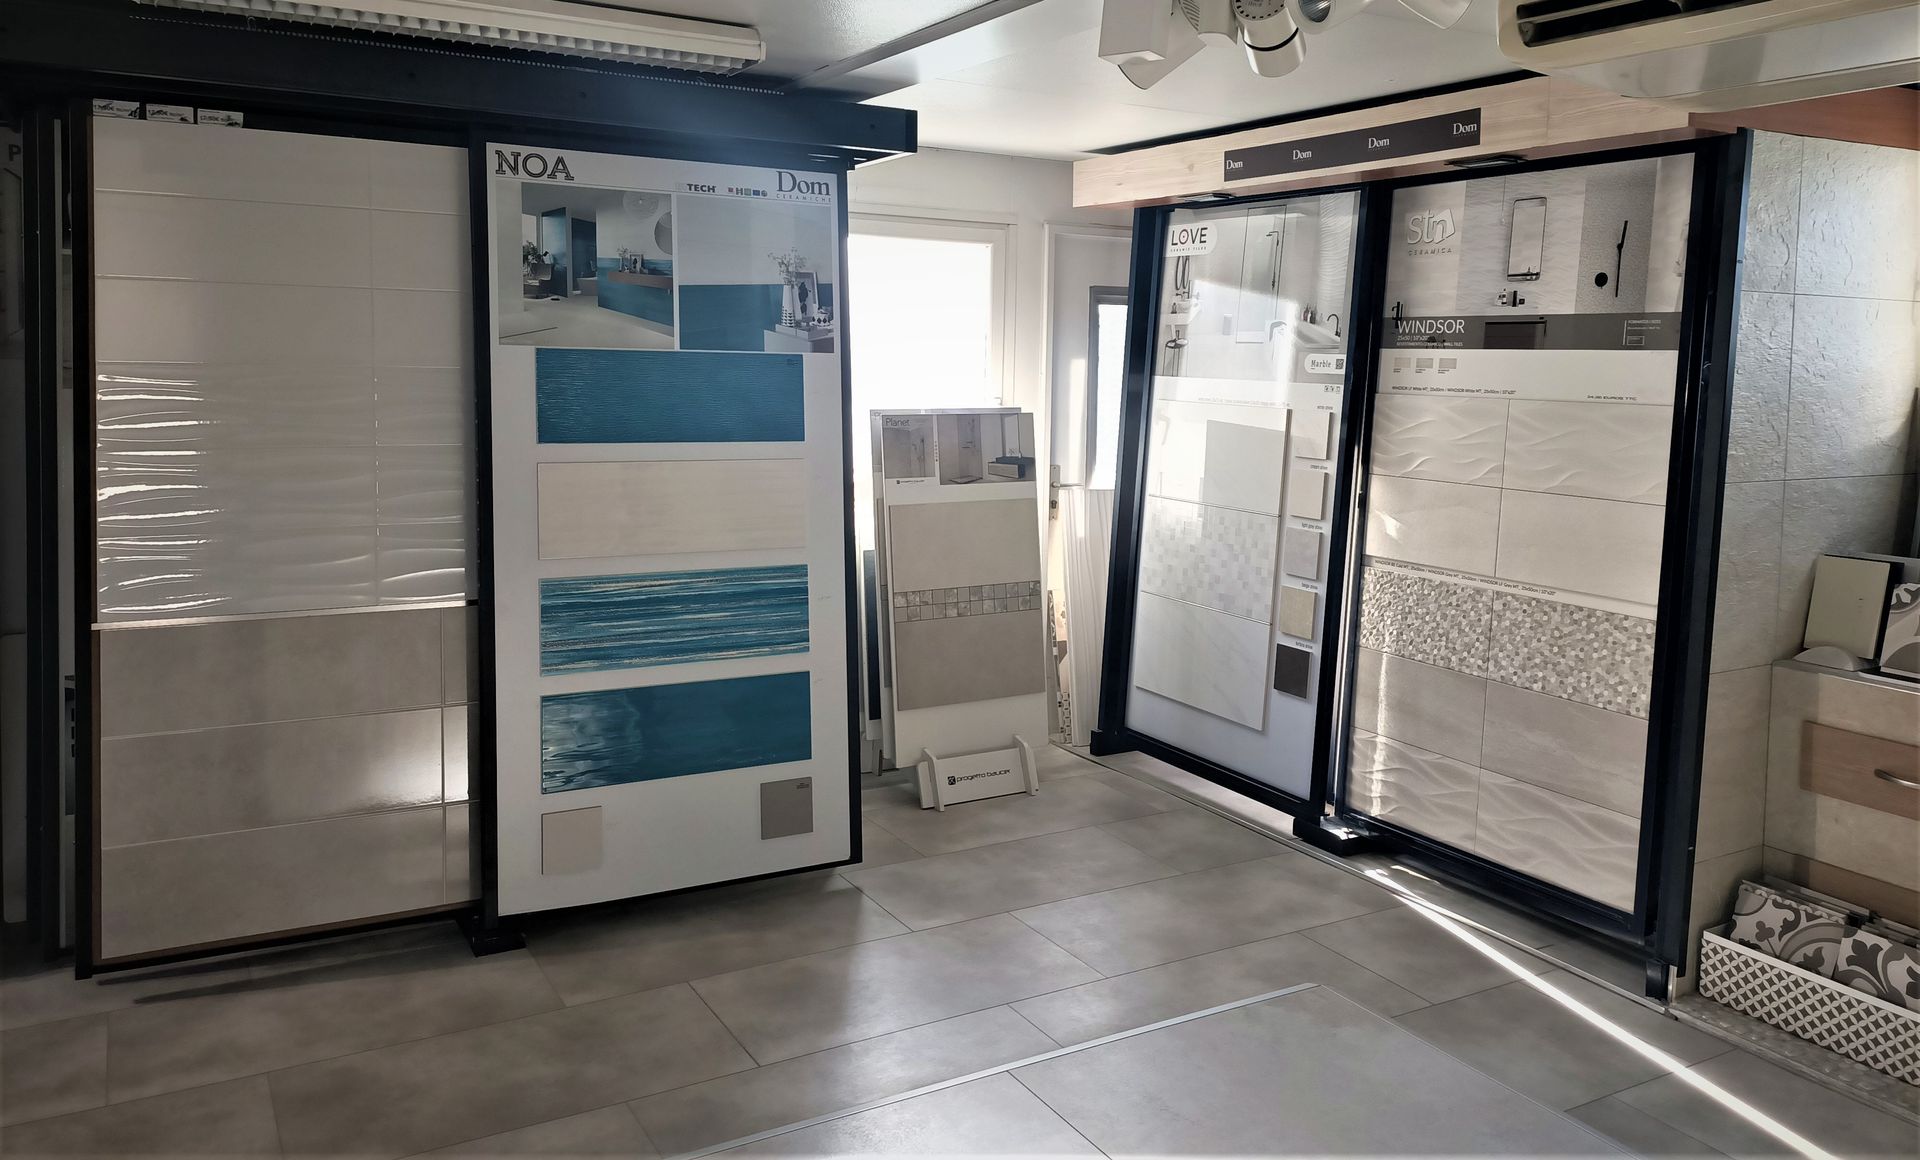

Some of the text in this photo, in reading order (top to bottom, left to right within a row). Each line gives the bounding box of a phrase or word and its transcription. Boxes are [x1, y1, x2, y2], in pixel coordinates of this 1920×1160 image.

[1452, 122, 1477, 135] Dom
[1368, 137, 1390, 149] Dom
[1292, 150, 1312, 160] Dom
[494, 149, 575, 181] NOA
[1226, 159, 1244, 170] Dom
[686, 183, 716, 193] TECH
[776, 170, 831, 196] Dom
[1171, 226, 1208, 246] LOVE
[1397, 319, 1465, 334] WINDSOR
[1311, 359, 1332, 368] Marble
[885, 417, 910, 427] Planet
